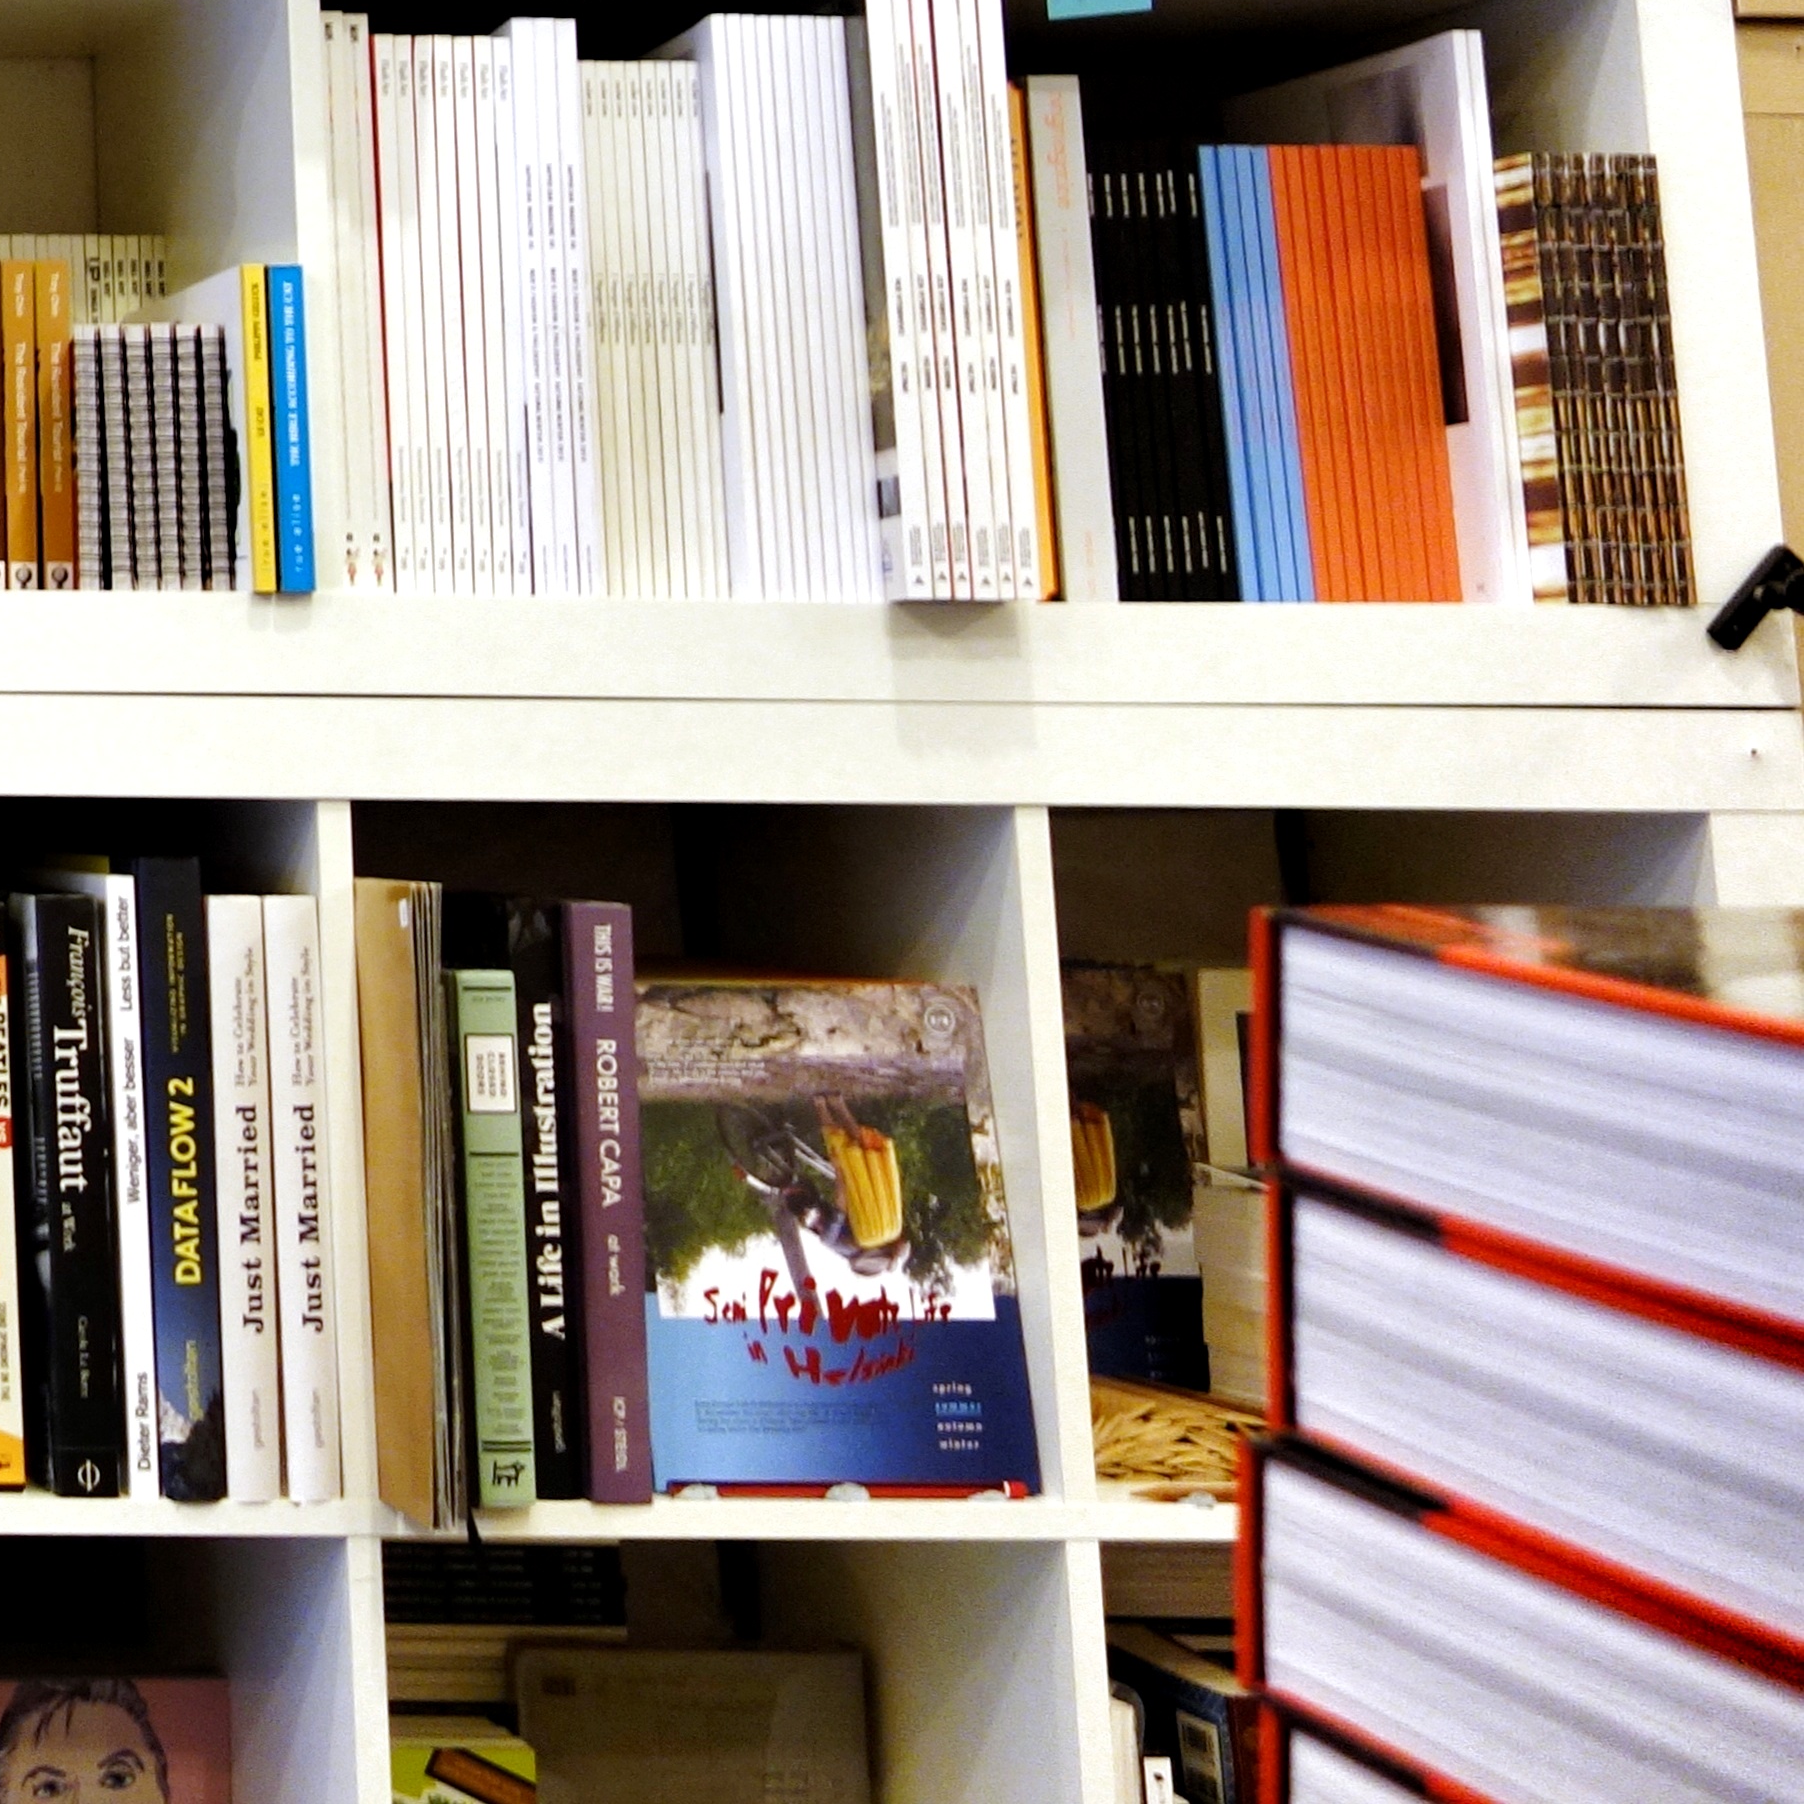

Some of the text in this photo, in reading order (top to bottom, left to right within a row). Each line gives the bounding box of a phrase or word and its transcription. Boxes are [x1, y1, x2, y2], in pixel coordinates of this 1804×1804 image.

[594, 923, 610, 957] THIS
[53, 926, 91, 1192] François Truffaut
[597, 1038, 620, 1137] ROBERT
[168, 1076, 199, 1285] DATAFLOW 2
[236, 1104, 264, 1333] Just Married
[527, 1003, 565, 1340] A Life in Illustration
[599, 1140, 622, 1208] CAPA
